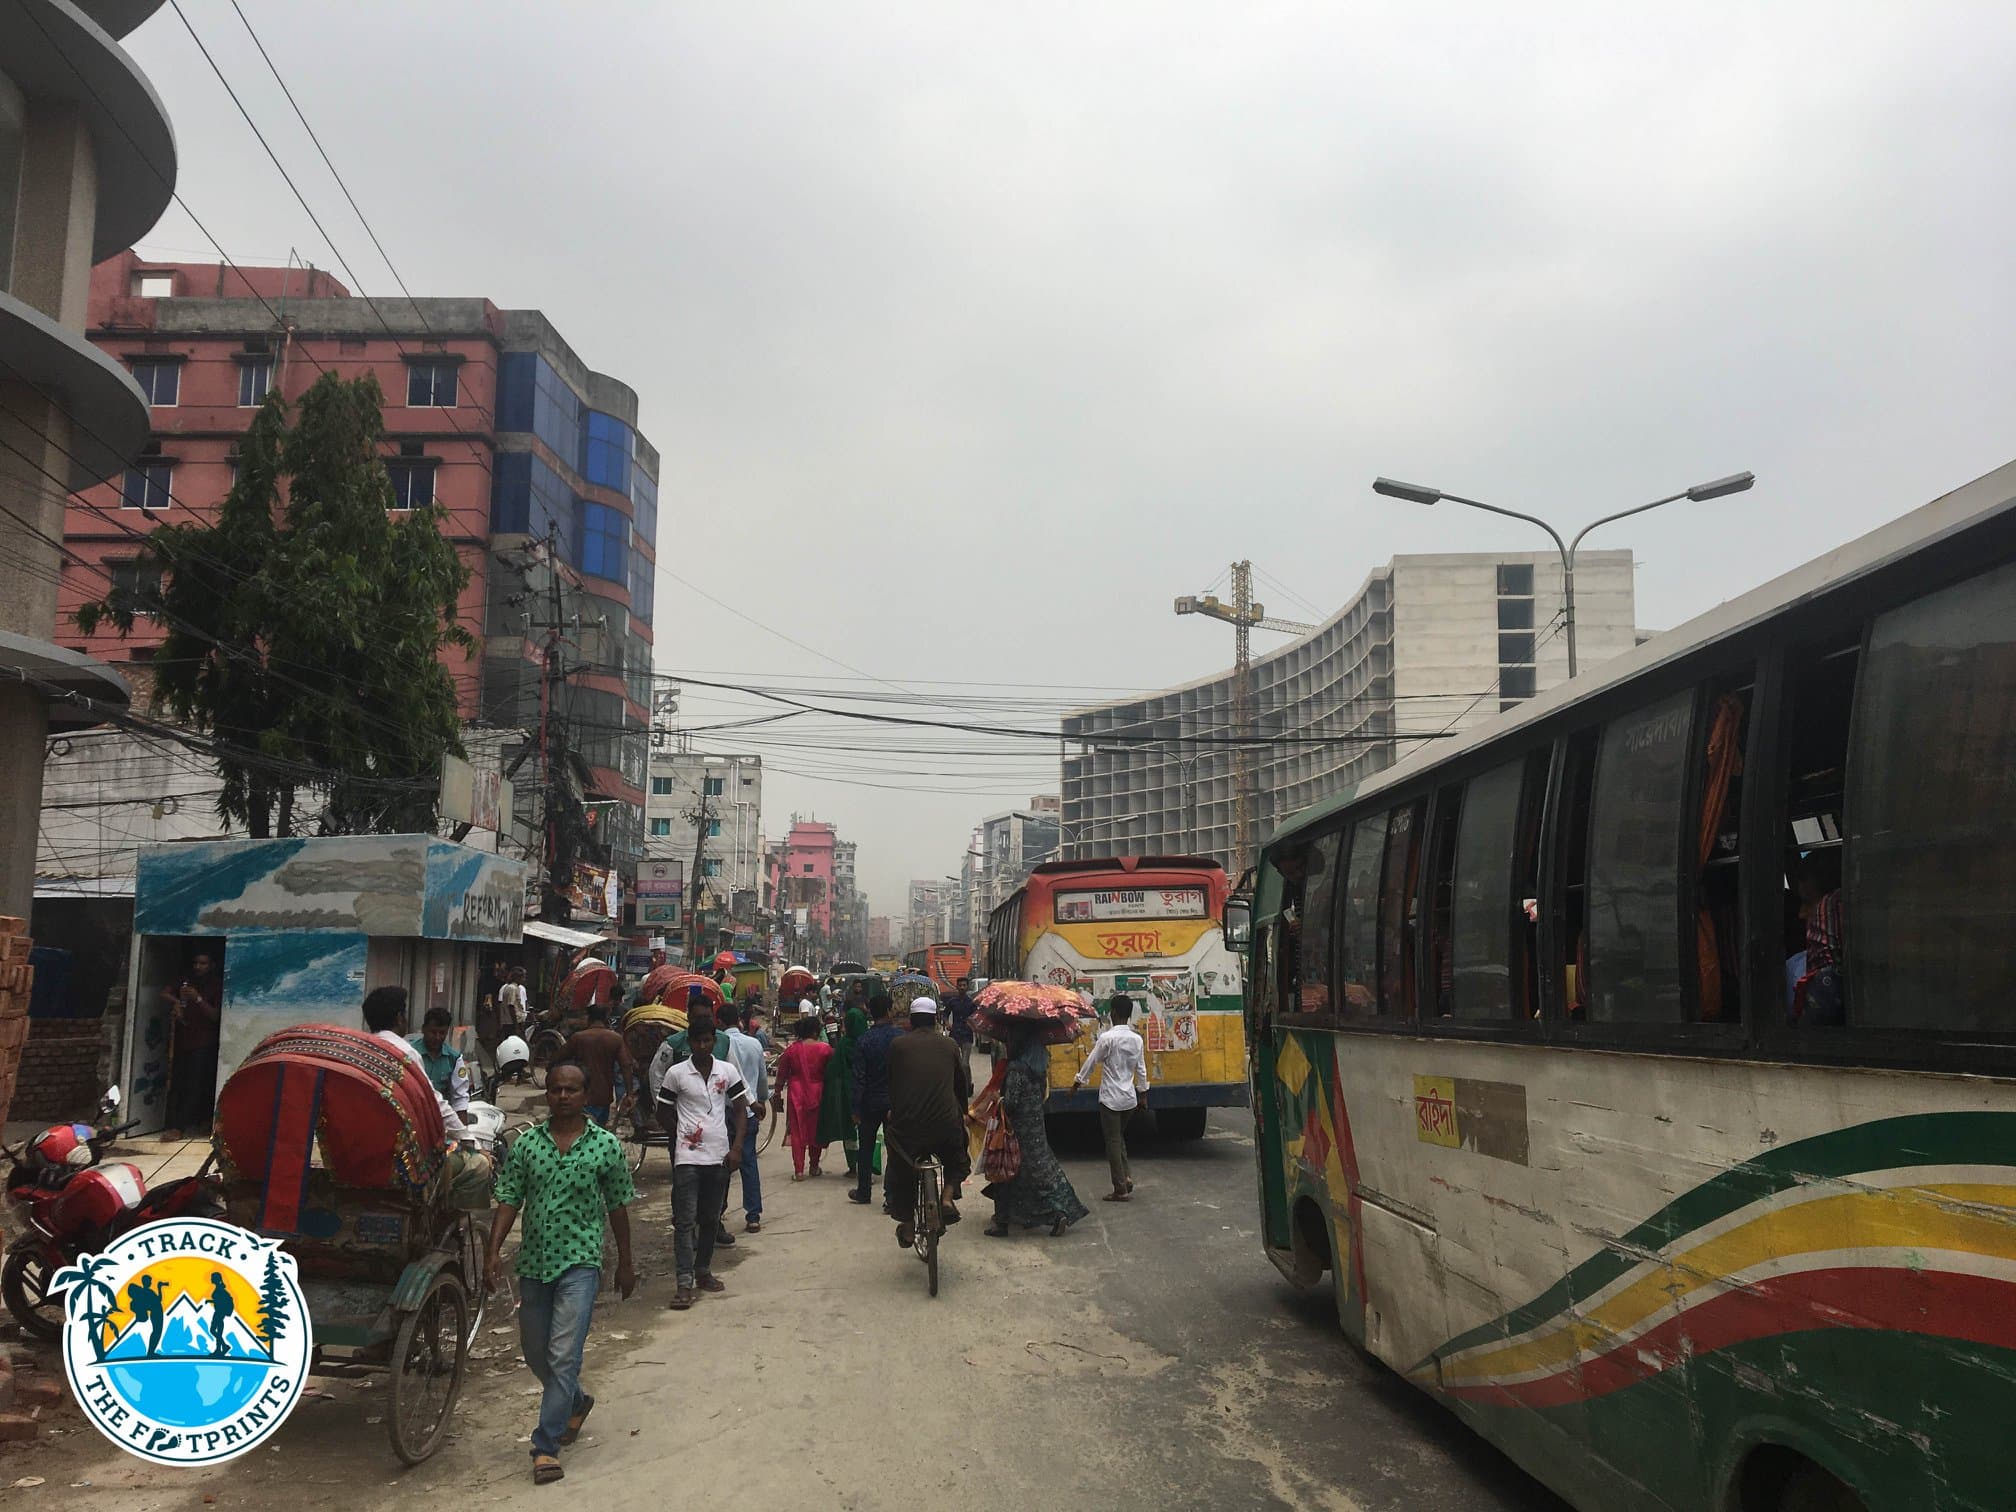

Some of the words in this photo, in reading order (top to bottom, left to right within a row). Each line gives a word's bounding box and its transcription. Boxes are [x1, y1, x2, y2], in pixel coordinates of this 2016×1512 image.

[1094, 891, 1145, 904] RAINBOW
[1159, 890, 1203, 908] তুরাগ
[1096, 930, 1162, 957] তুরাগ
[1415, 1087, 1455, 1136] রাইদা
